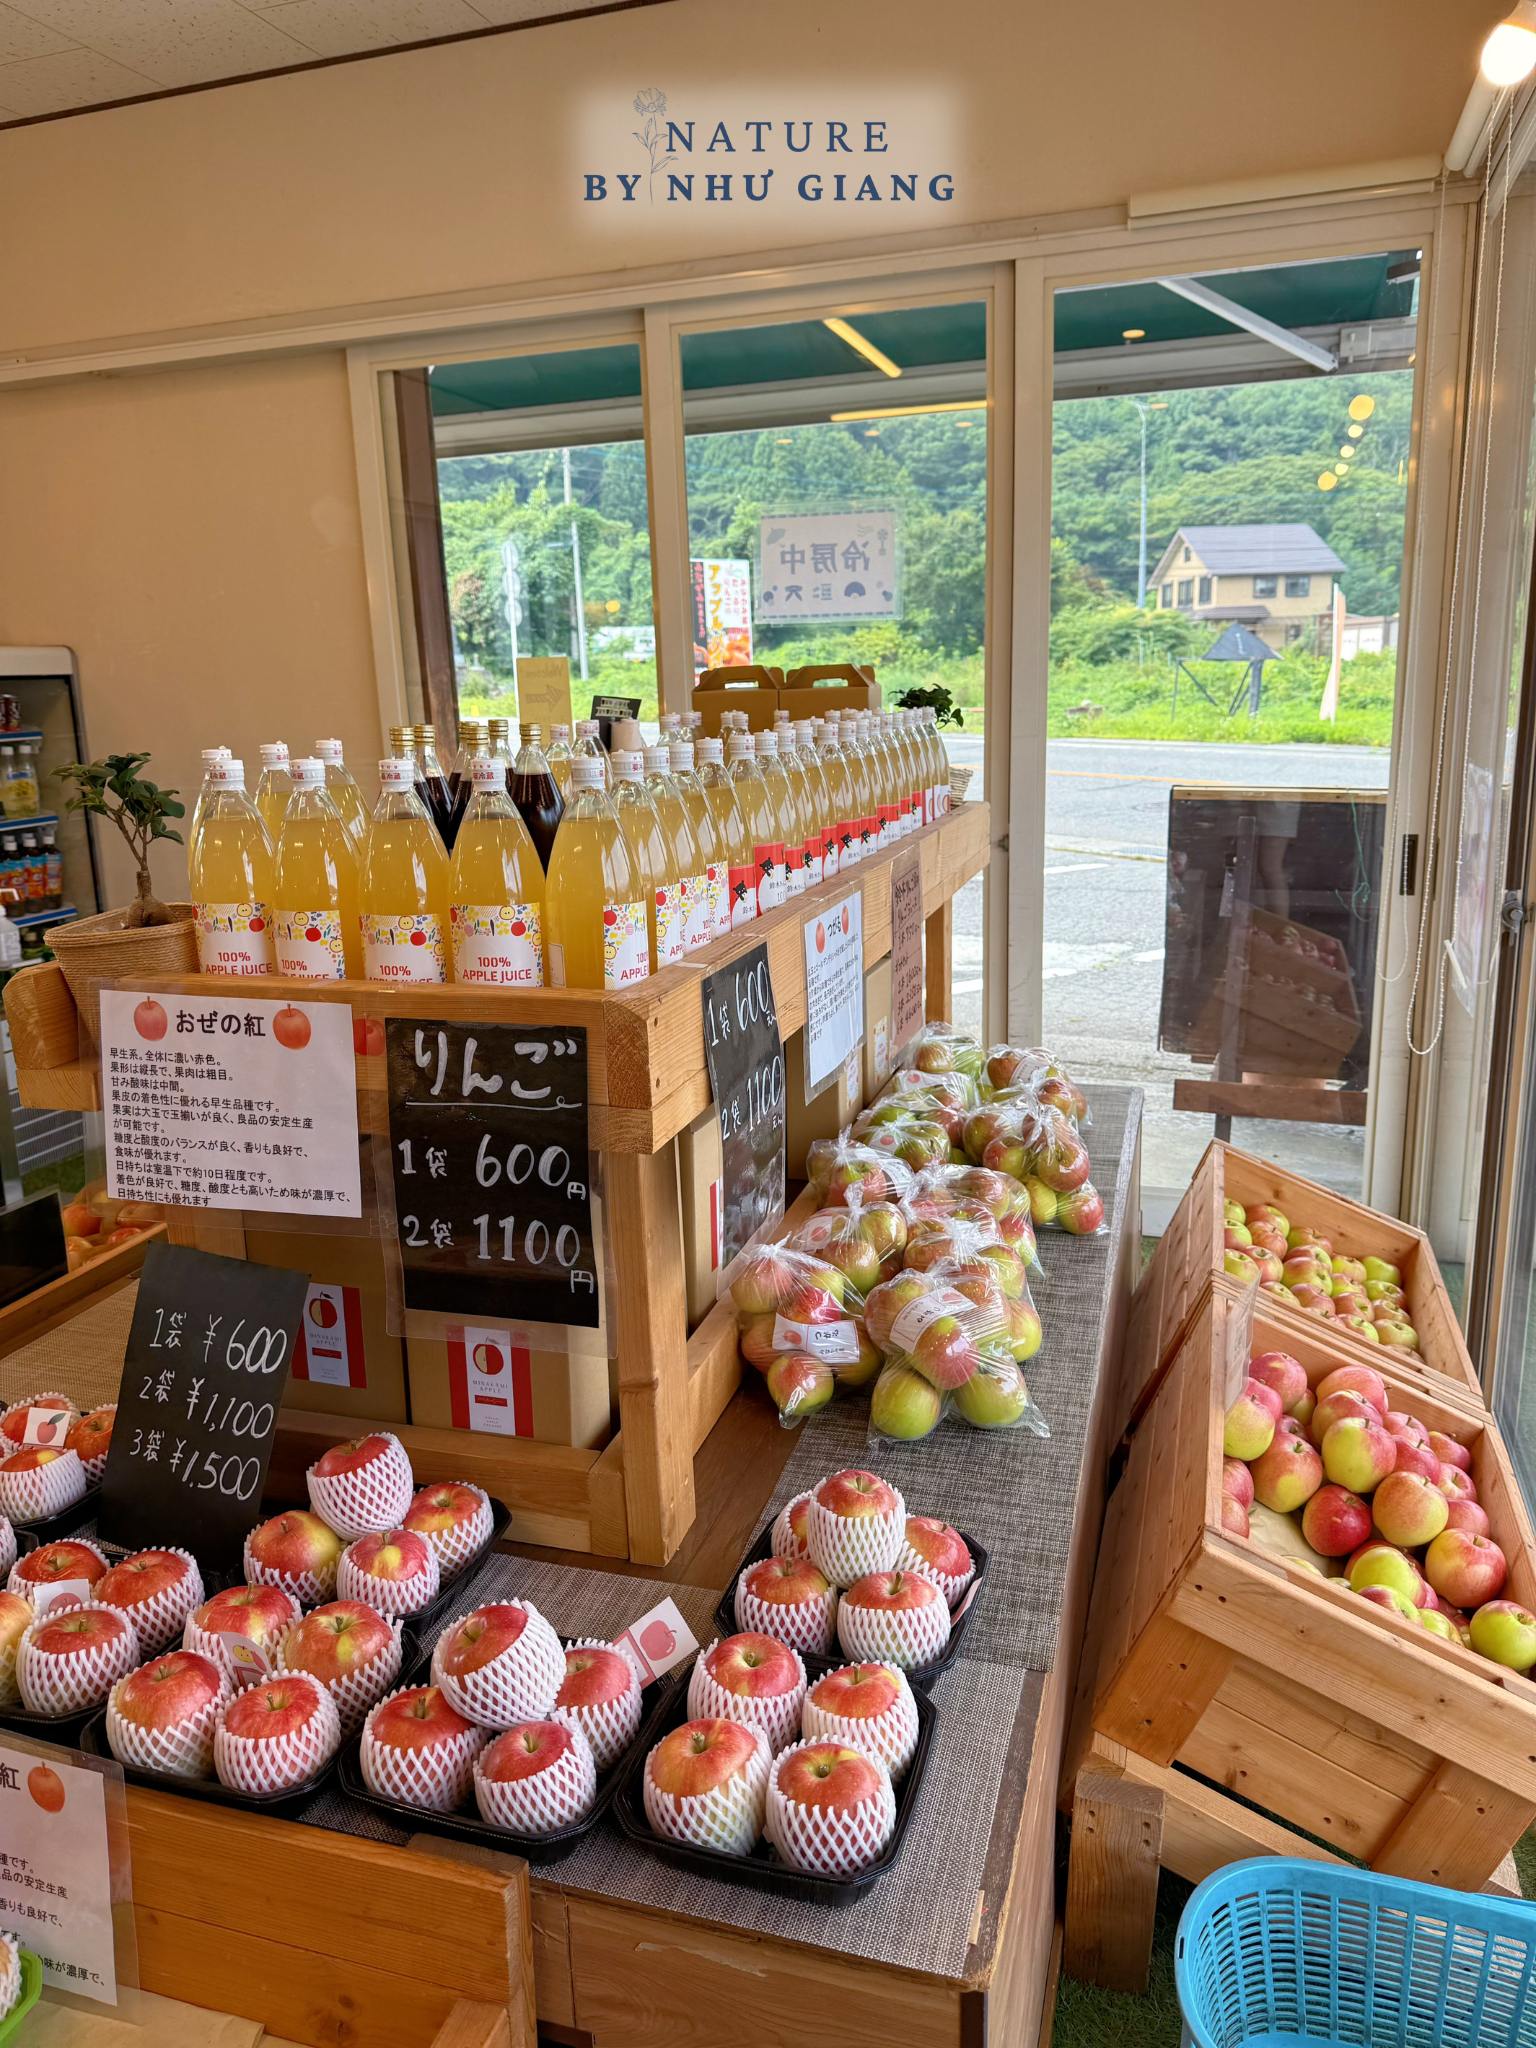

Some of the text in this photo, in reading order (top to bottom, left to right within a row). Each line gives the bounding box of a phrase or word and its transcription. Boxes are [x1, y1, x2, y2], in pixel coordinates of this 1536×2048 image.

[218, 952, 250, 962] 100%
[282, 959, 308, 971] 100%
[477, 956, 511, 968] 100%
[205, 964, 238, 975] APPLE
[380, 965, 411, 976] 100%
[463, 969, 532, 983] APPLE JUICE
[176, 1010, 266, 1037] おぜの紅
[110, 1048, 222, 1066] 早生系。全体に濃い赤色。
[414, 1029, 577, 1099] りんご
[113, 1118, 165, 1133] が可能です。
[115, 1147, 187, 1164] 食味が優れます。
[398, 1134, 586, 1200] 1袋 600円
[403, 1213, 594, 1293] 2袋 1100円
[149, 1308, 287, 1373] 1袋 ¥600
[139, 1369, 274, 1439] 2袋 ¥1,100
[129, 1429, 165, 1462] 3袋
[0, 1868, 68, 1899] 品の安定生産
